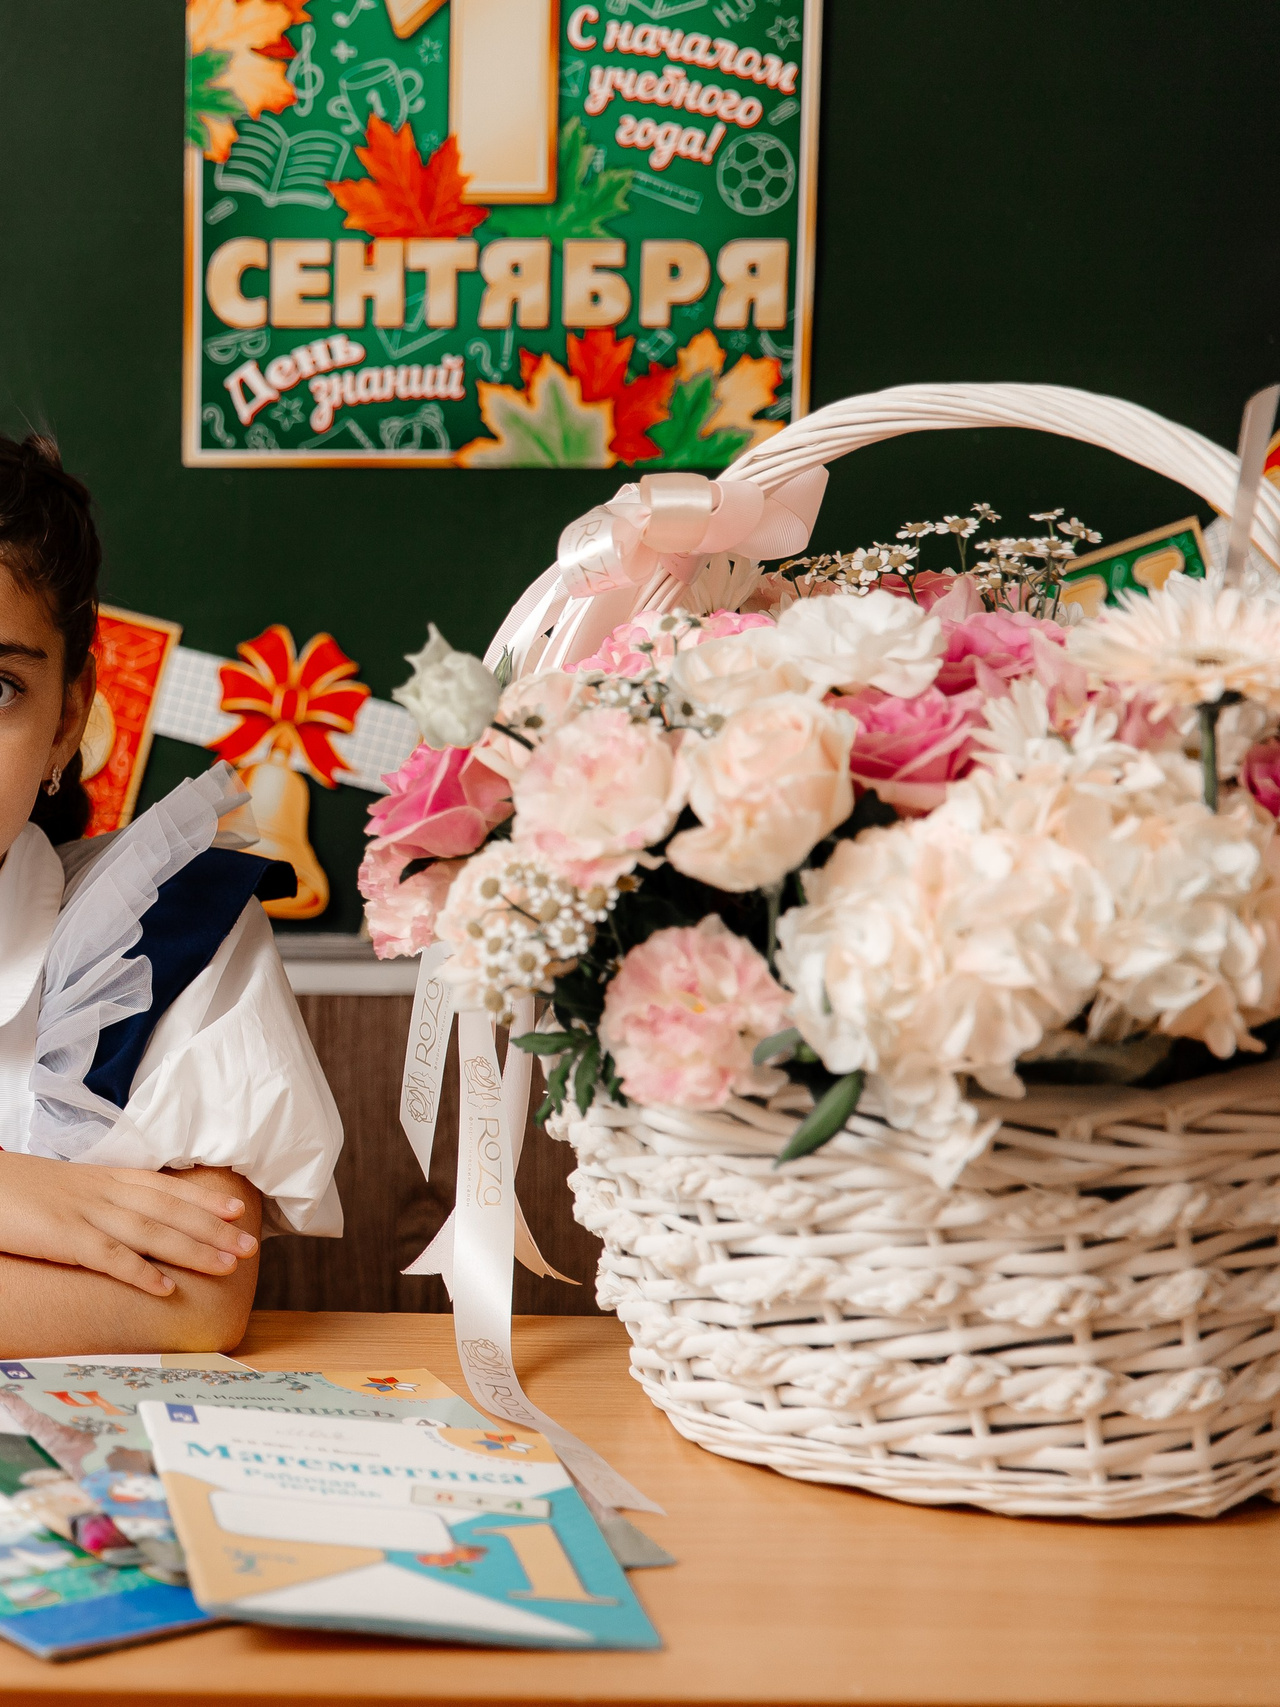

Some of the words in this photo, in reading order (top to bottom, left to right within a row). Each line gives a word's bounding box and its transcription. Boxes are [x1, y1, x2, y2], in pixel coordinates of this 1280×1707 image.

[567, 5, 600, 51] С
[603, 19, 800, 95] началом
[584, 64, 763, 128] учебного
[615, 114, 727, 171] года!
[206, 239, 790, 329] СЕНТЯБРЯ
[223, 333, 366, 426] День
[308, 353, 466, 434] знаний
[184, 1440, 529, 1485] Математика
[472, 1522, 621, 1607] 1
